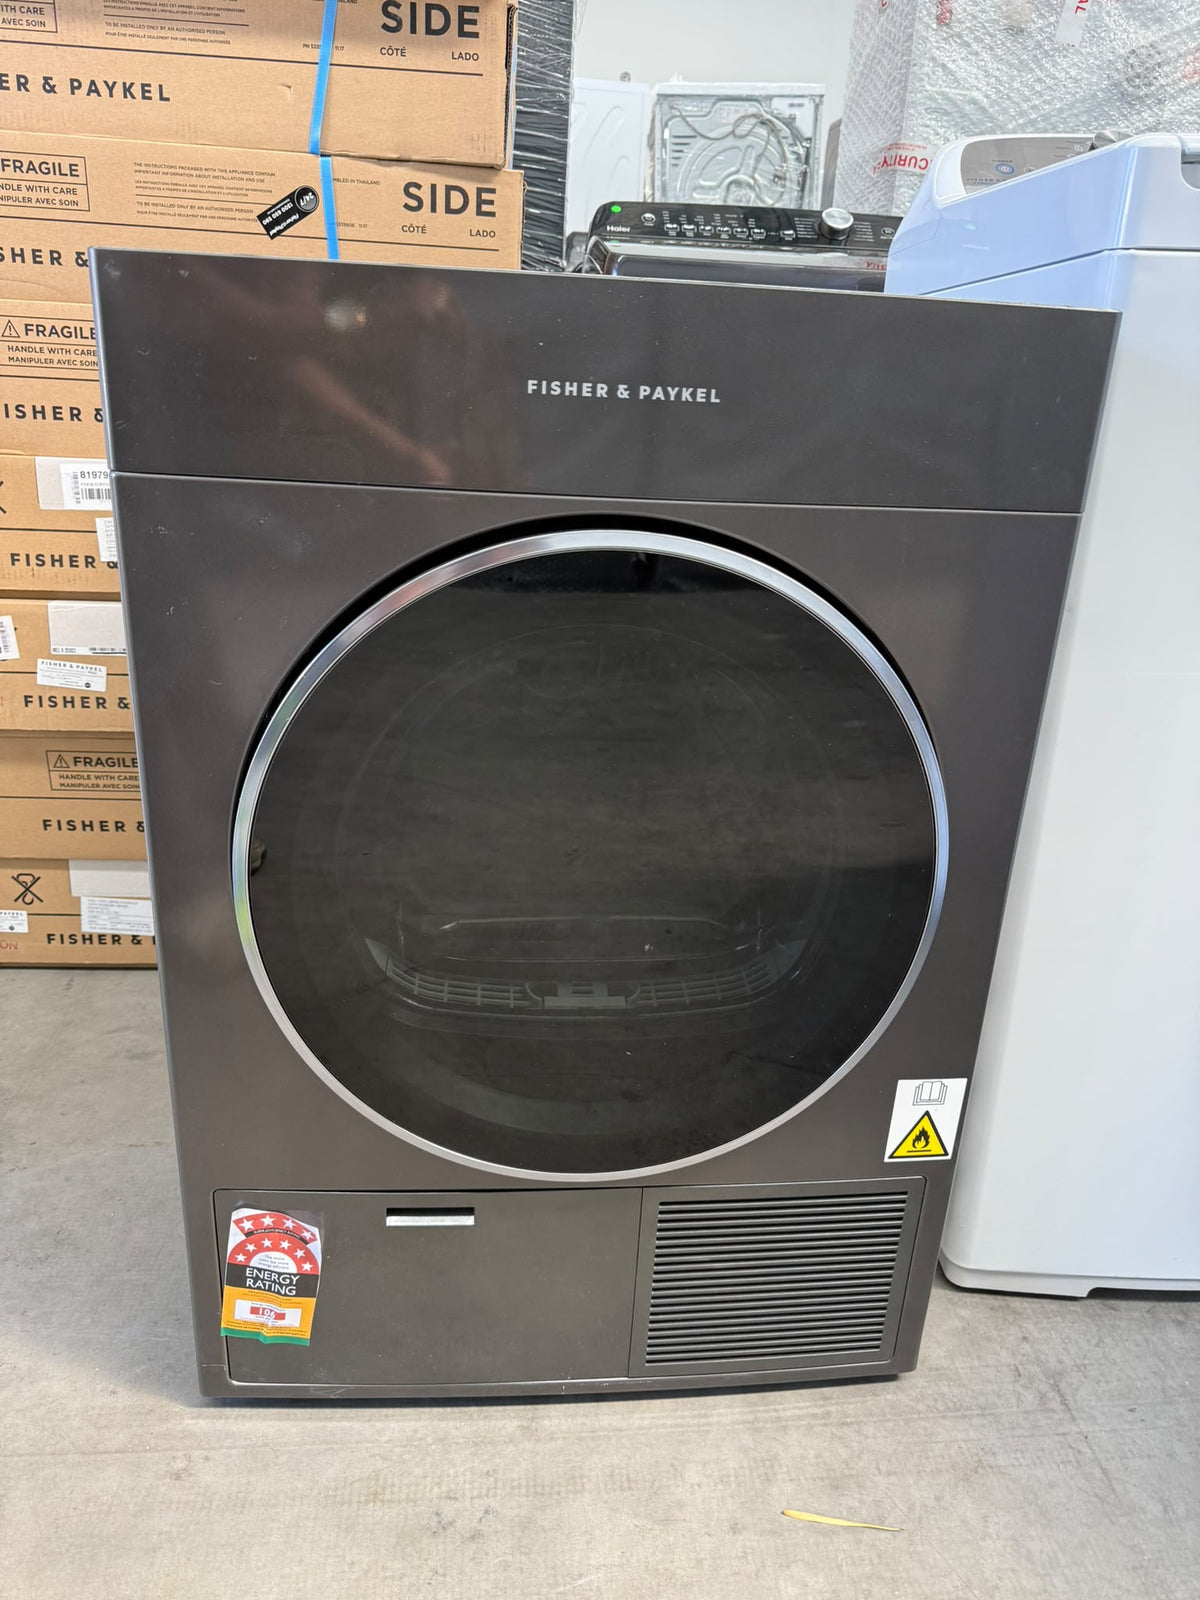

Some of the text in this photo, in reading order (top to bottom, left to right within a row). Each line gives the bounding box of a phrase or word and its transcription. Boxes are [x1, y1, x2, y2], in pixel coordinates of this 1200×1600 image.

[0, 4, 45, 15] ITH CARE
[26, 19, 46, 27] SOIN
[381, 0, 480, 38] SIDE
[380, 45, 406, 57] CÔTÉ
[452, 51, 479, 62] LADO
[42, 76, 57, 94] &
[69, 78, 170, 102] PAYKEL
[0, 158, 79, 177] FRAGILE
[881, 154, 929, 170] CURITY
[25, 184, 50, 193] WITH
[53, 187, 78, 195] CARE
[35, 198, 56, 206] AVEC
[59, 198, 78, 207] SOIN
[300, 192, 314, 206] 24/7
[403, 181, 497, 217] SIDE
[401, 223, 427, 234] CÔTÉ
[470, 229, 496, 238] LADO
[75, 251, 89, 267] &
[24, 323, 96, 340] FRAGILE
[8, 345, 44, 354] HANDLE
[47, 347, 71, 355] WITH
[8, 356, 54, 365] MANIPULER
[528, 380, 720, 403] FISHER & PAYKEL
[4, 403, 82, 422] ISHER
[10, 553, 96, 569] FISHER
[24, 695, 130, 710] FISHER &
[73, 756, 138, 768] FRAGILE
[43, 819, 126, 832] FISHER
[47, 933, 122, 945] FISHER
[131, 935, 142, 945] &
[246, 1268, 300, 1285] ENERGY
[246, 1278, 296, 1296] RATING
[259, 1308, 276, 1319] 106
